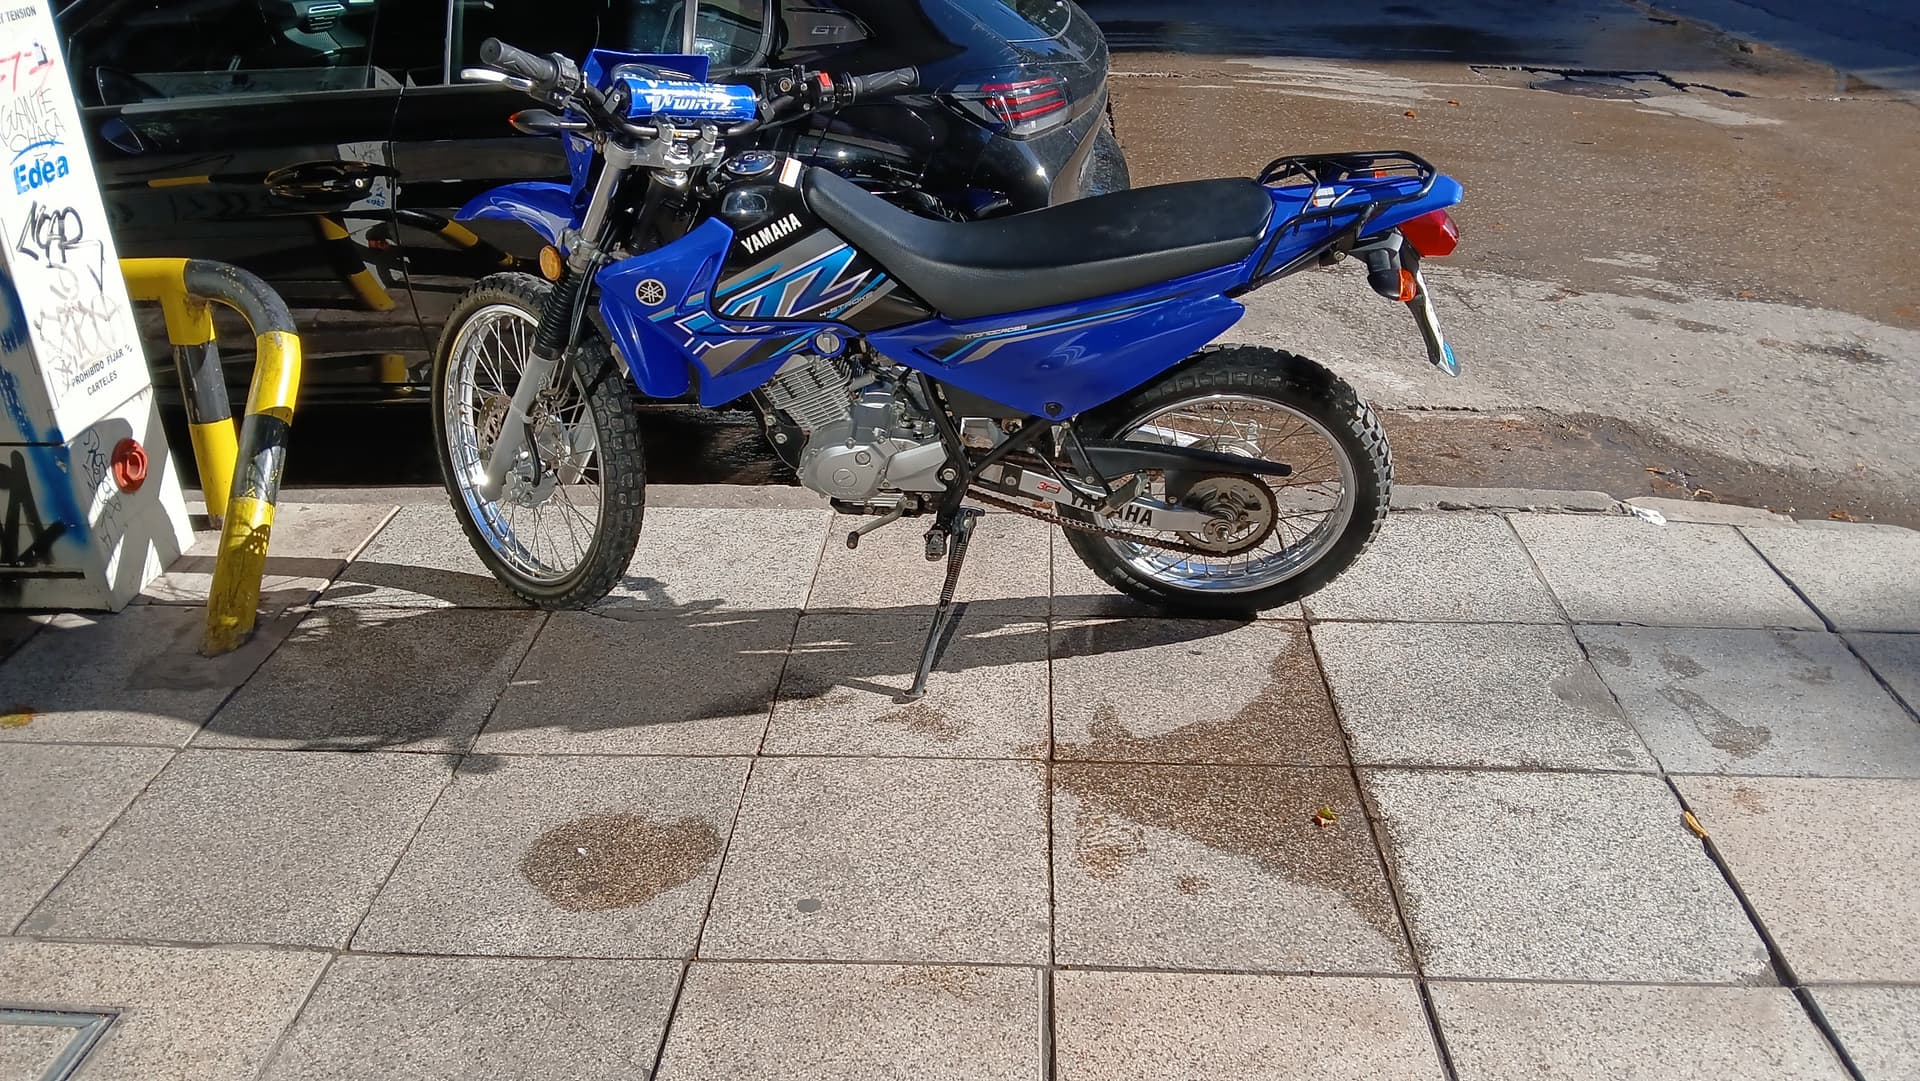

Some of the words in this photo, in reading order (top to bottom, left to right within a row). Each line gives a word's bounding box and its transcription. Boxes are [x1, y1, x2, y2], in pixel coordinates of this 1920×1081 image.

[5, 5, 36, 22] TENSION
[812, 25, 847, 34] GT
[671, 97, 743, 111] WIRTZ
[13, 155, 69, 195] Edea
[741, 213, 802, 254] YAMAHA
[72, 360, 105, 387] PROHIBIDO
[106, 348, 124, 365] FIJAR
[87, 370, 118, 396] CARTELES
